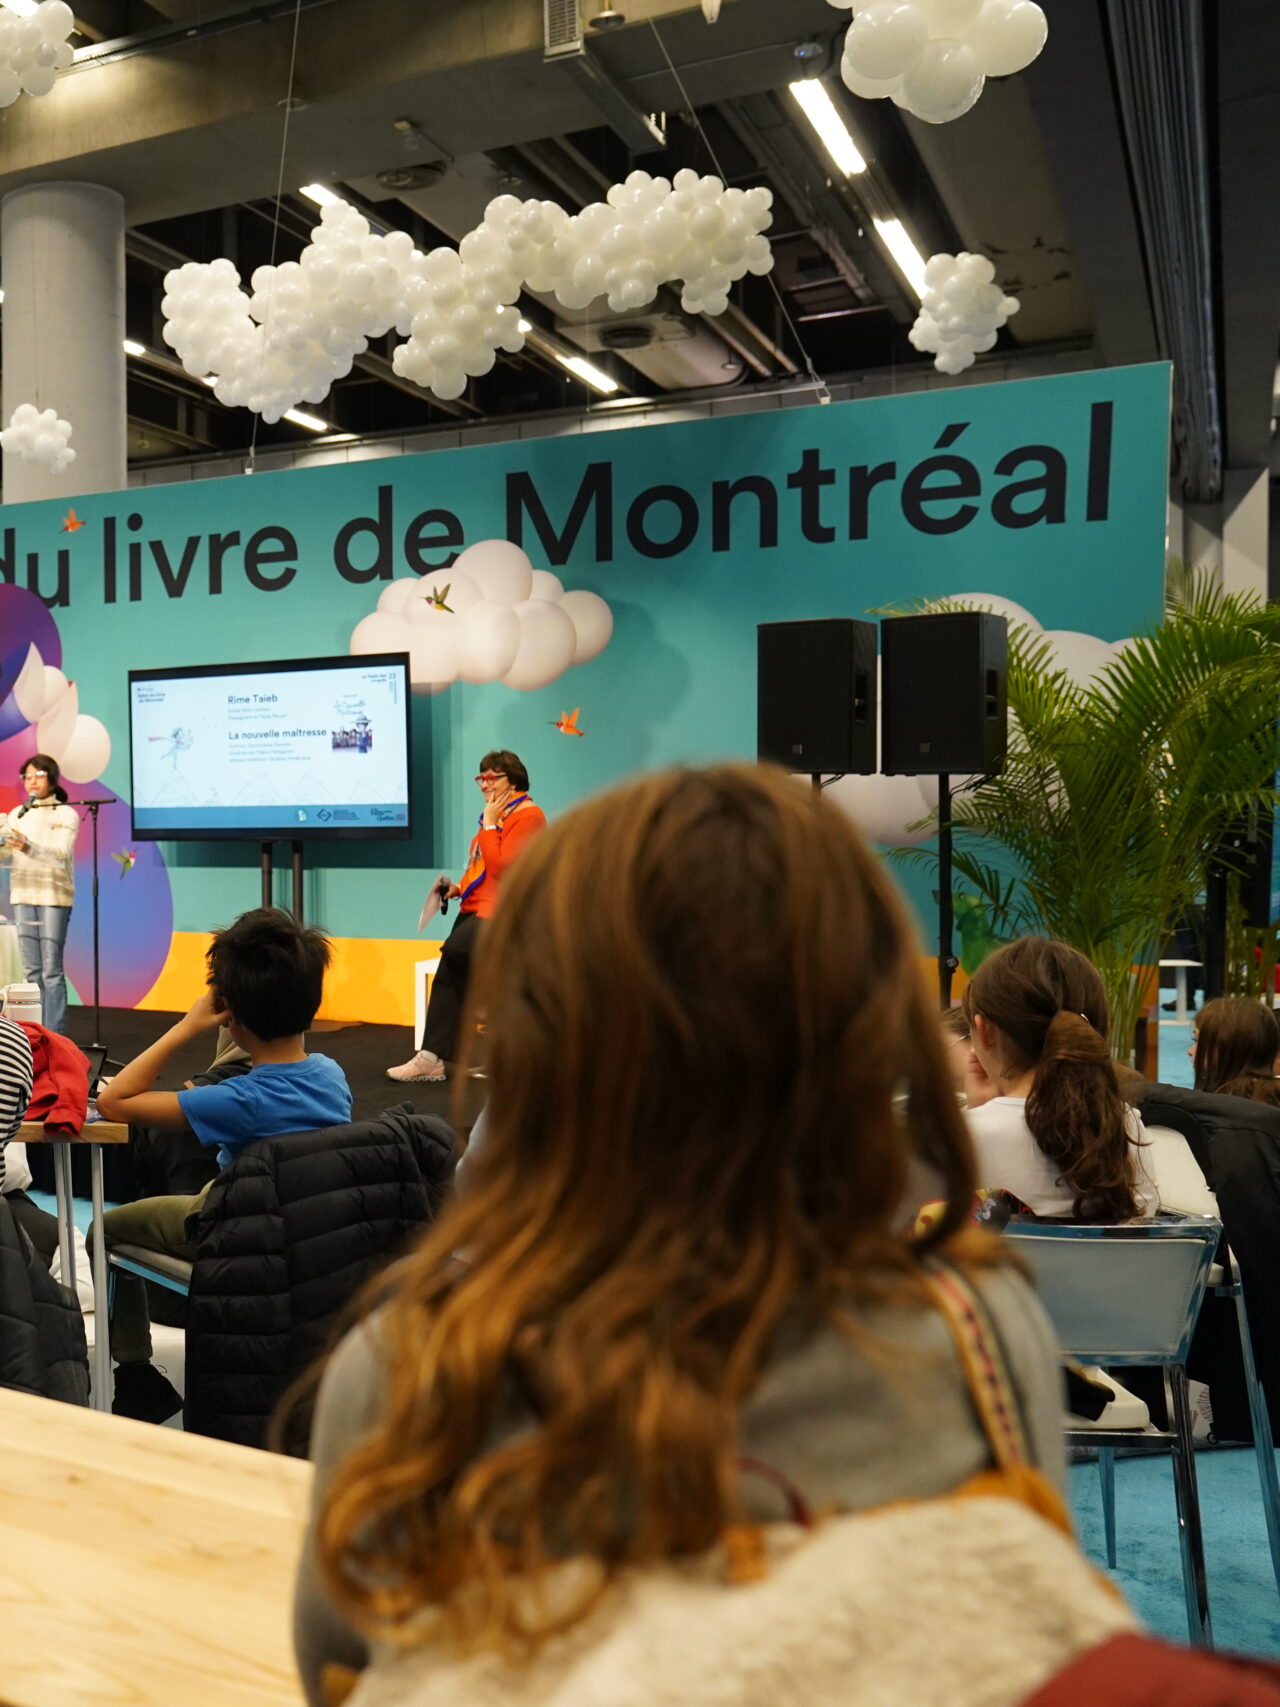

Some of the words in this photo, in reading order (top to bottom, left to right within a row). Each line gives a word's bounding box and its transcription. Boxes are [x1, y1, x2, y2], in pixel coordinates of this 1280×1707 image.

[102, 512, 298, 605] livre
[332, 484, 465, 582] de
[504, 400, 1115, 568] Montréal
[227, 695, 250, 705] Rime
[228, 731, 239, 740] La
[241, 729, 280, 739] nouvelle
[282, 728, 327, 738] maîtresse
